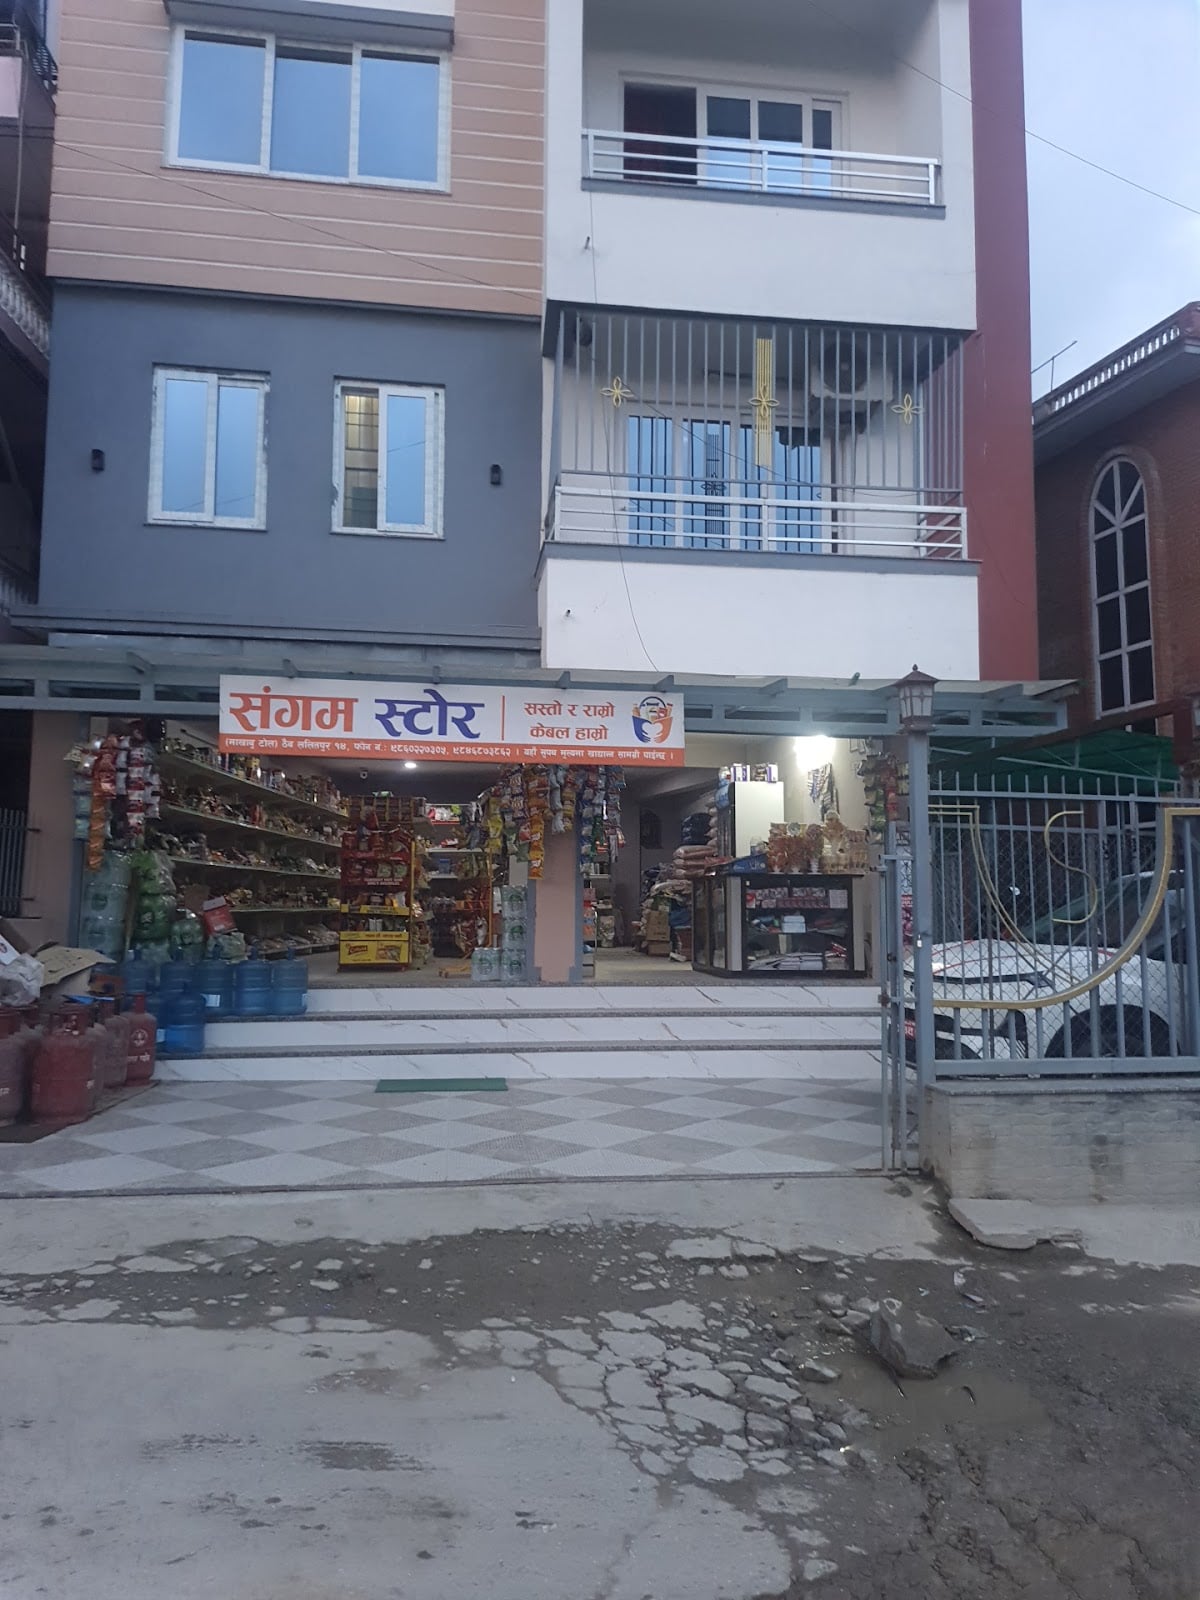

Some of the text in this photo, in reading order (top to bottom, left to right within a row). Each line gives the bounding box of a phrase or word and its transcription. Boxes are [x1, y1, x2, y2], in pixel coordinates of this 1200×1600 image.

[229, 685, 485, 739] संगम स्टोर
[524, 700, 616, 719] सस्तो र राम्रो
[530, 722, 609, 741] केबल हाम्रो
[297, 739, 331, 752] ललितपुर
